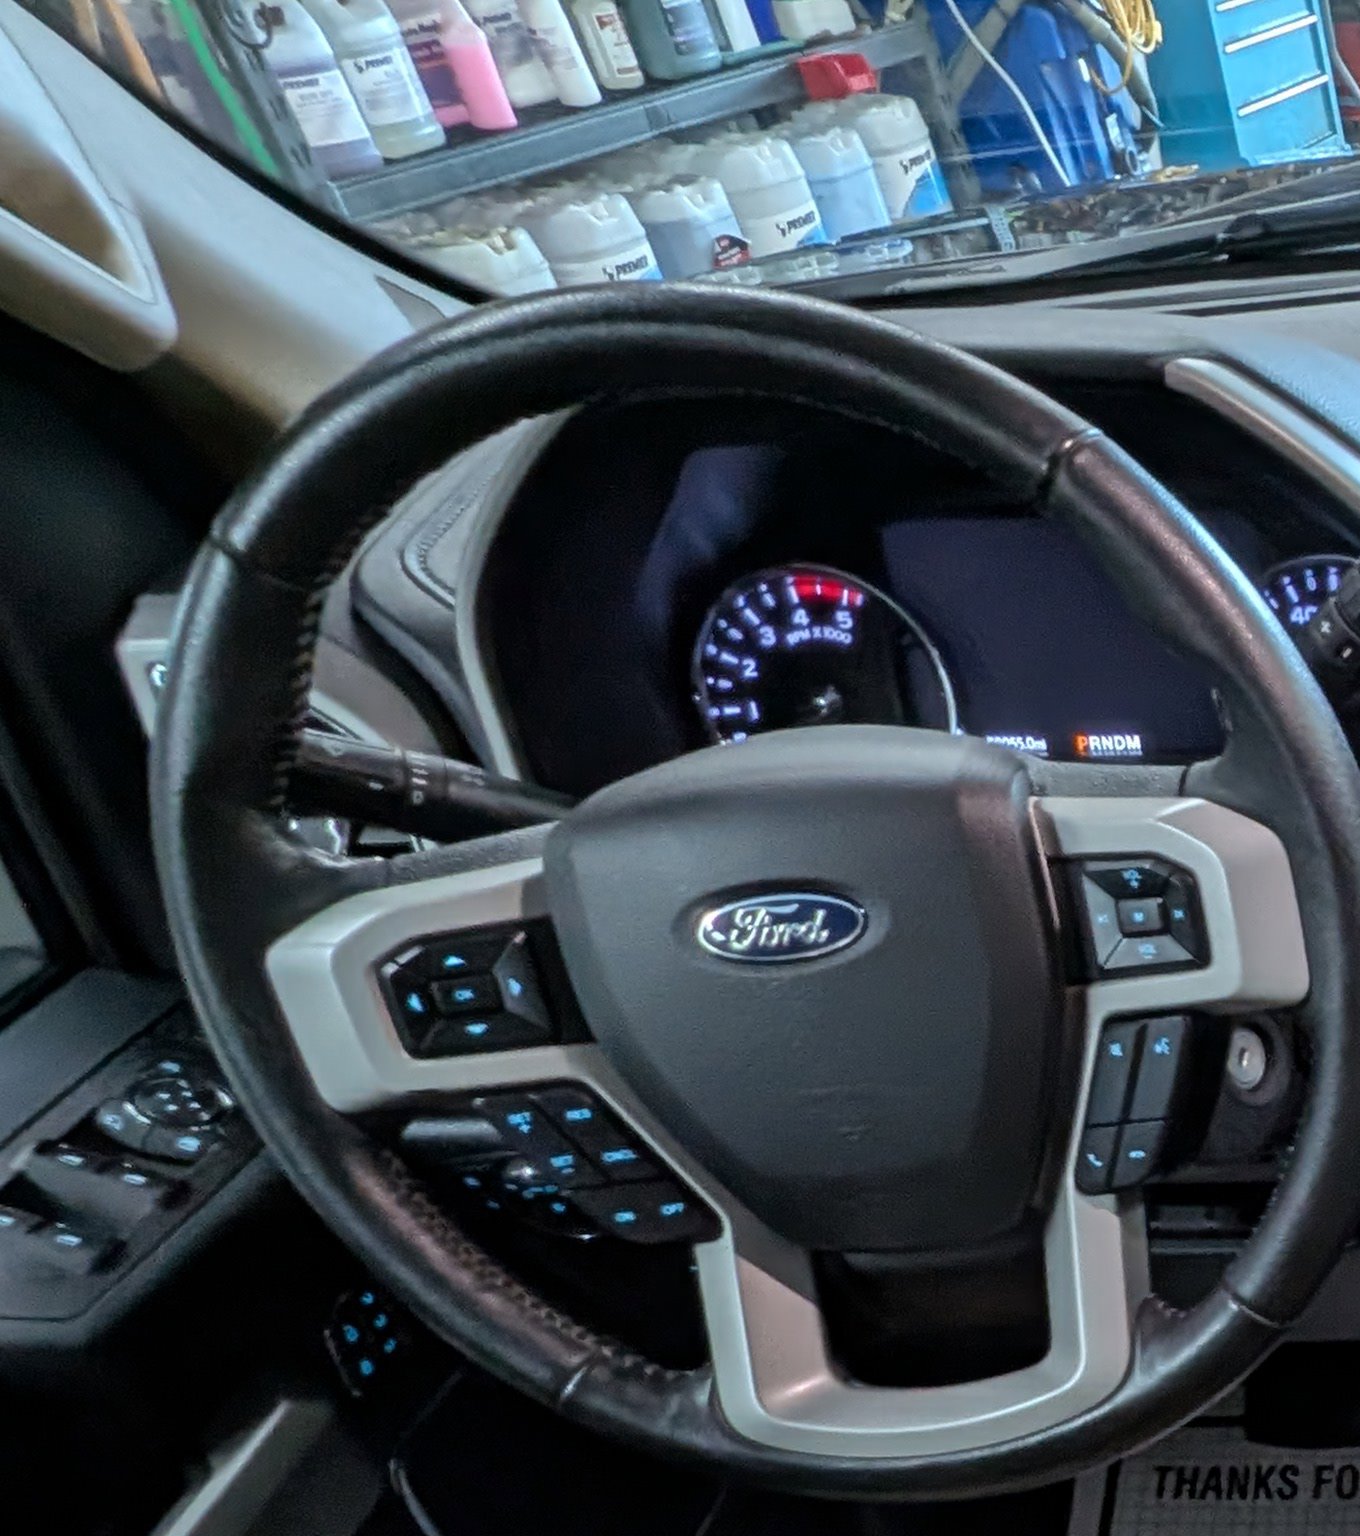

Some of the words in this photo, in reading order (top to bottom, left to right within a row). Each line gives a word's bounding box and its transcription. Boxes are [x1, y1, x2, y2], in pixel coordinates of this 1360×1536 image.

[792, 608, 810, 626] 4
[835, 611, 853, 630] 5
[760, 626, 776, 647] 3
[786, 628, 811, 646] RPM
[823, 627, 853, 645] 1000
[742, 658, 758, 678] 2
[750, 701, 760, 721] 1
[730, 903, 830, 950] Ford
[1154, 1464, 1299, 1501] THANKS
